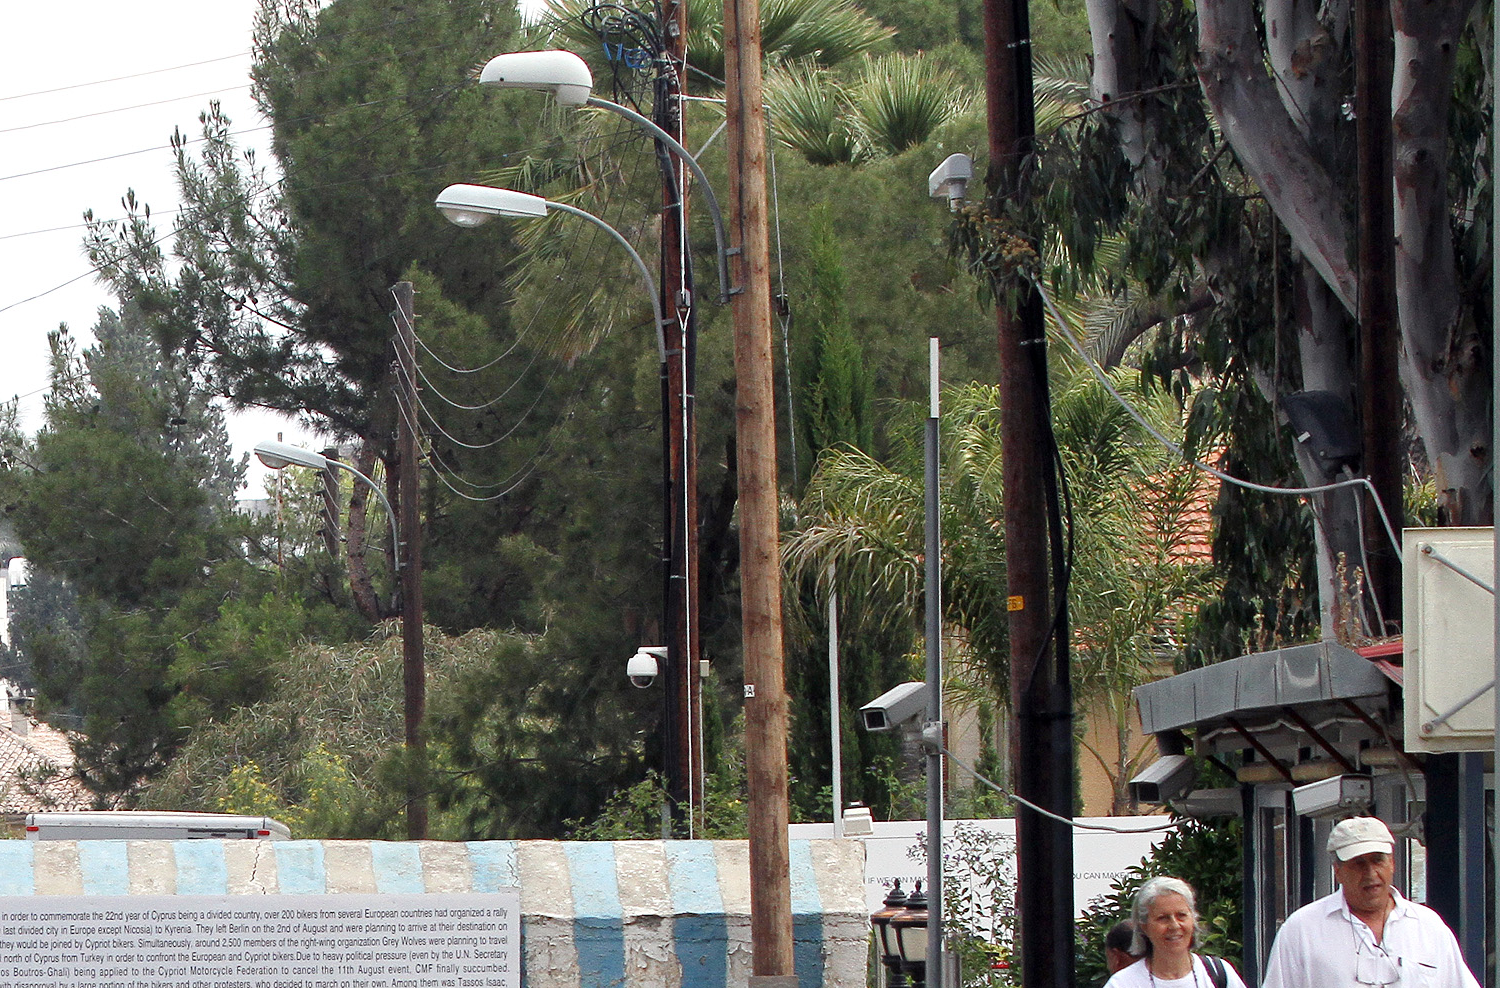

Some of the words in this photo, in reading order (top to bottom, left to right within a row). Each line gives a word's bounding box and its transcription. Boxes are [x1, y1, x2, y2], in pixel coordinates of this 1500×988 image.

[1, 912, 8, 921] in
[10, 911, 28, 921] order
[30, 912, 38, 920] to
[39, 912, 90, 920] commemorate
[92, 911, 103, 920] the
[105, 910, 123, 920] 22nd
[124, 912, 140, 922] year
[142, 910, 149, 920] of
[150, 910, 176, 922] Cyprus
[178, 910, 198, 921] being
[206, 910, 232, 919] divided
[281, 909, 294, 919] 200
[296, 909, 318, 919] bikers
[319, 909, 336, 918] from
[337, 909, 362, 918] several
[73, 966, 96, 978] being
[99, 966, 128, 978] applied
[131, 967, 139, 976] to
[142, 966, 154, 976] the
[158, 966, 186, 978] Cypriot
[190, 966, 232, 977] Motorcycle
[236, 965, 278, 975] Federation
[281, 966, 289, 975] to
[292, 965, 318, 975] cancel
[321, 965, 334, 974] the
[338, 965, 354, 974] 11th
[357, 964, 384, 976] August
[415, 964, 432, 974] CMF
[436, 964, 459, 976] finally
